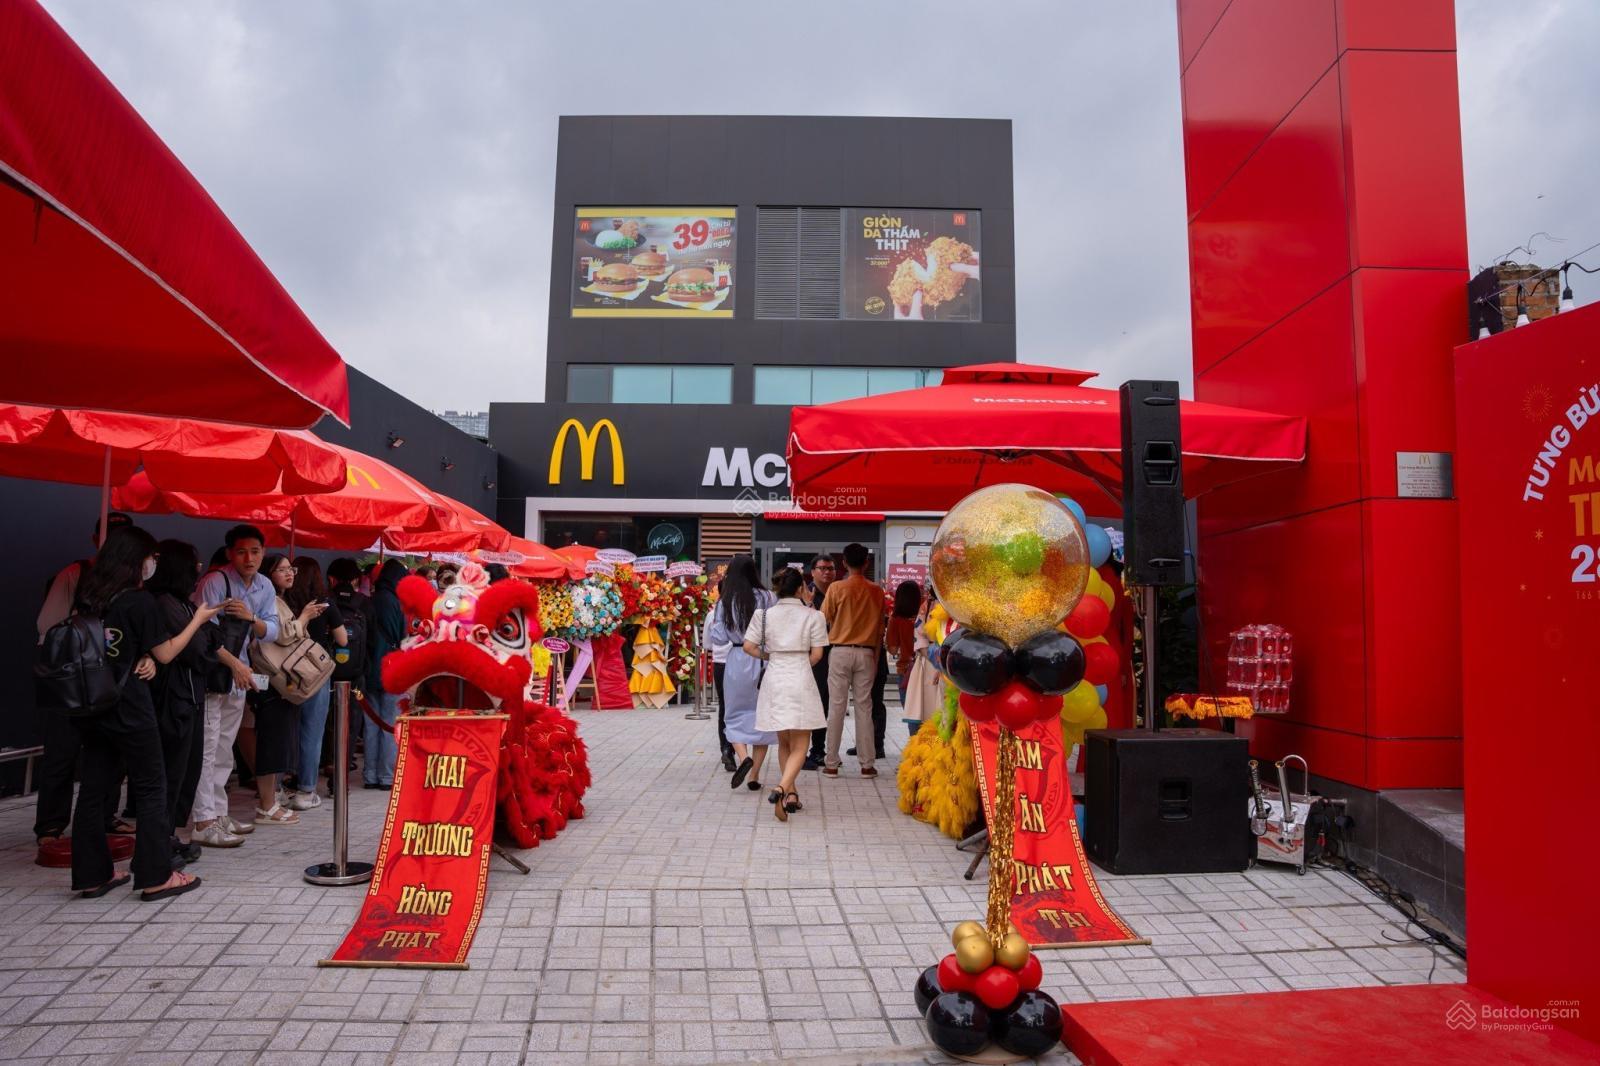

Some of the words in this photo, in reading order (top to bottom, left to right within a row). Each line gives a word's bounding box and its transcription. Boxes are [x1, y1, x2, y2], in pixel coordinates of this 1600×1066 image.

[672, 219, 709, 250] 39
[863, 214, 902, 228] GIÒN
[864, 228, 881, 238] DA
[875, 239, 909, 254] THỊT
[701, 447, 792, 487] Mc
[1012, 735, 1044, 770] ÀM
[425, 753, 467, 789] KHAI
[1018, 793, 1047, 833] ĂN
[1013, 862, 1073, 895] PHÁT
